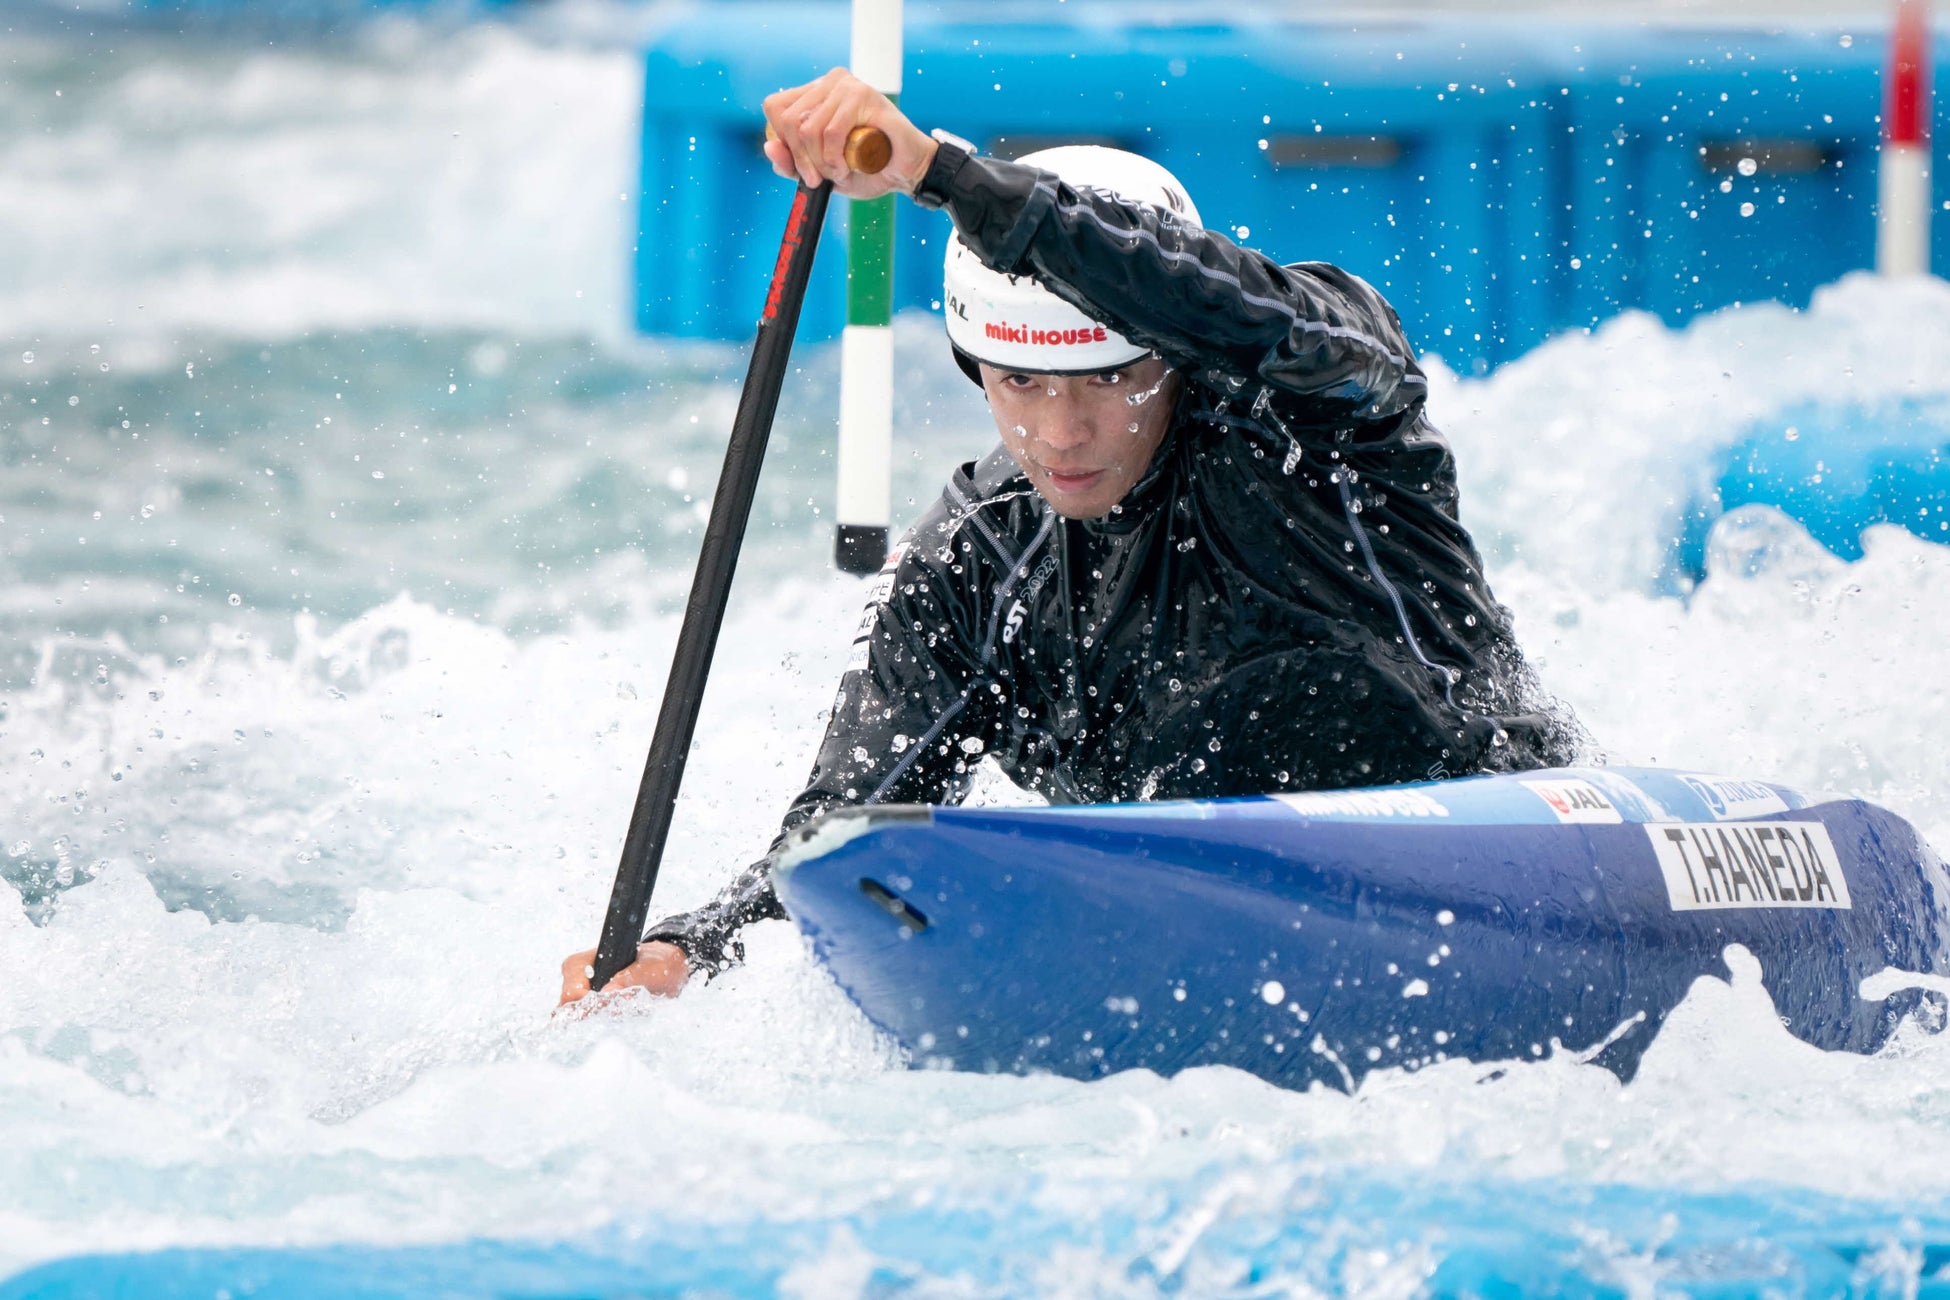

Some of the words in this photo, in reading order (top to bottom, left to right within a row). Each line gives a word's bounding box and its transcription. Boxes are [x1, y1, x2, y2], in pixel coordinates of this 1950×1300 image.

[1031, 326, 1108, 346] HOUSE
[1020, 555, 1059, 603] 2022
[1563, 788, 1611, 809] JAL
[1664, 827, 1838, 903] T.HANEDA
